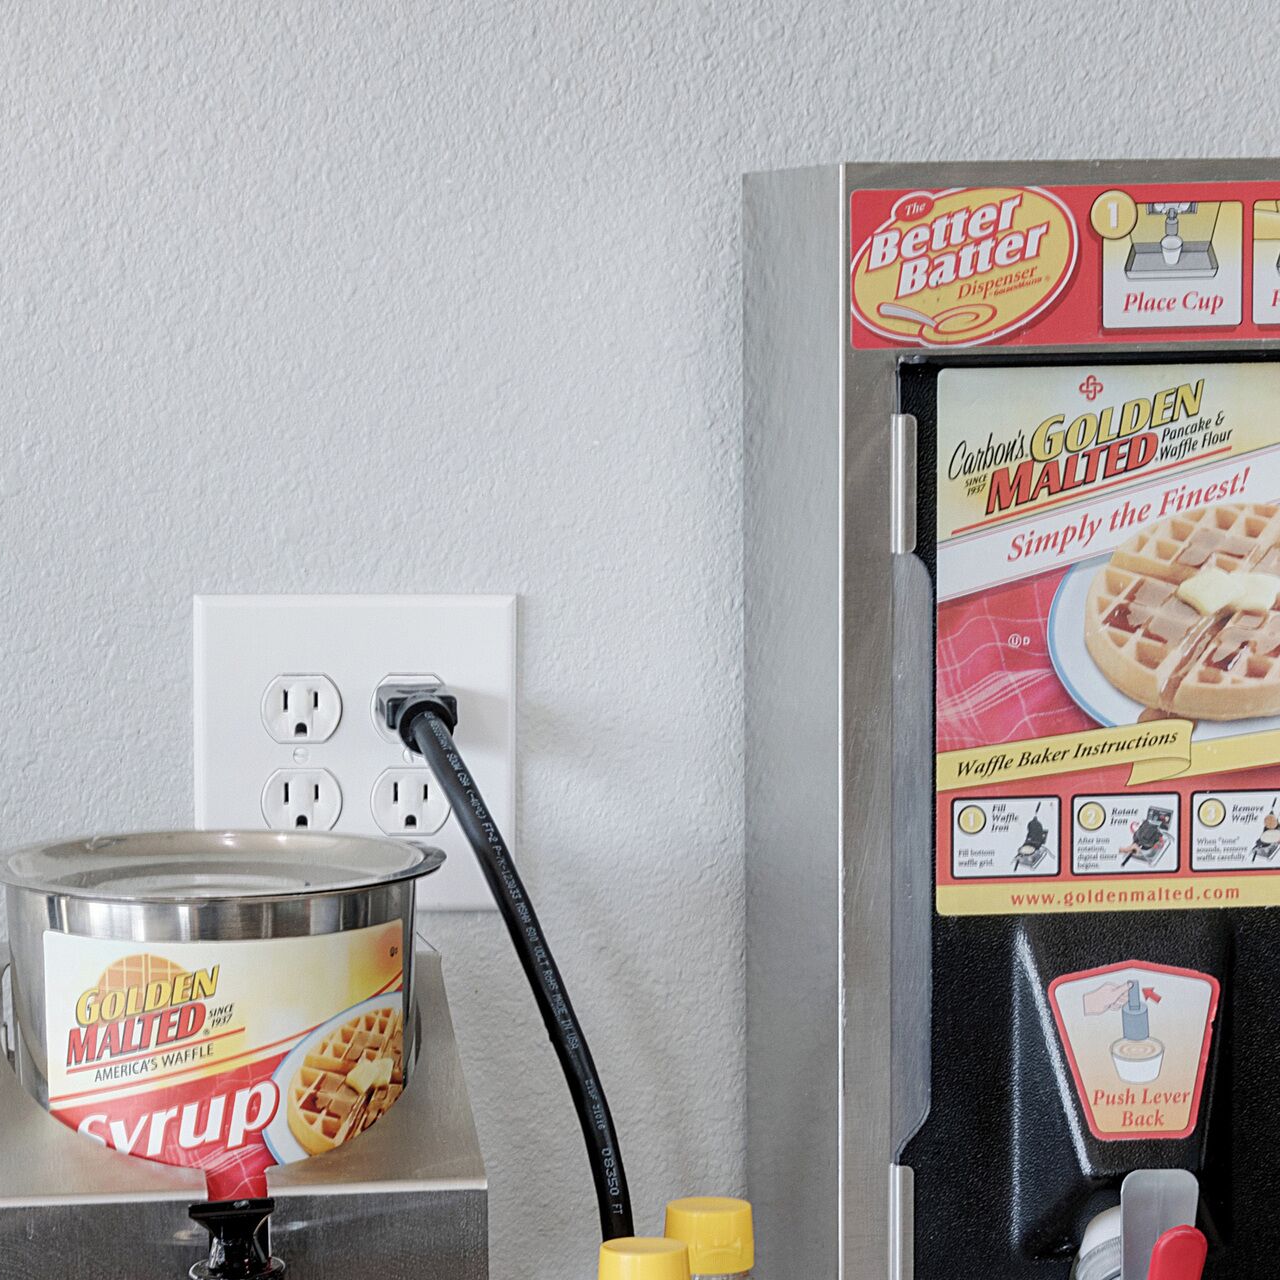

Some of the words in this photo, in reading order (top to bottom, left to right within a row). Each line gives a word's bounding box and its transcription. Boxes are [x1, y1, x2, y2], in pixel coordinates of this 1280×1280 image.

[904, 202, 926, 217] The
[867, 194, 1023, 272] Better
[897, 222, 1049, 298] Batter
[958, 265, 1038, 299] Dispenser
[1123, 291, 1176, 315] Place
[1182, 290, 1224, 315] Cup
[948, 429, 1025, 480] Carbon's
[1030, 379, 1205, 463] GOLDEN
[1161, 417, 1212, 443] Pancake
[1215, 410, 1225, 426] &
[1160, 437, 1198, 460] Waffle
[1202, 428, 1233, 448] Flour
[965, 473, 988, 487] SINCE
[967, 483, 986, 496] 1937
[985, 432, 1159, 515] MALTED
[1007, 513, 1103, 563] Simply
[1109, 501, 1149, 530] the
[1159, 466, 1251, 518] Finest!
[957, 753, 1013, 778] Waffle
[1017, 747, 1070, 768] Baker
[1072, 730, 1179, 760] Instructions
[992, 804, 1006, 812] Fill
[1011, 886, 1240, 907] www.goldenmalted.com
[75, 964, 220, 1028] GOLDEN
[208, 1002, 235, 1019] SINCE
[66, 1002, 207, 1067] MALTED
[211, 1014, 233, 1028] 1937
[94, 1058, 158, 1083] AMERICA'S
[161, 1042, 214, 1068] WAFFLE
[1093, 1088, 1136, 1107] Push
[1141, 1088, 1190, 1105] Lever
[1121, 1110, 1165, 1128] Back
[601, 1147, 620, 1197] 08350
[611, 1202, 624, 1216] FT
